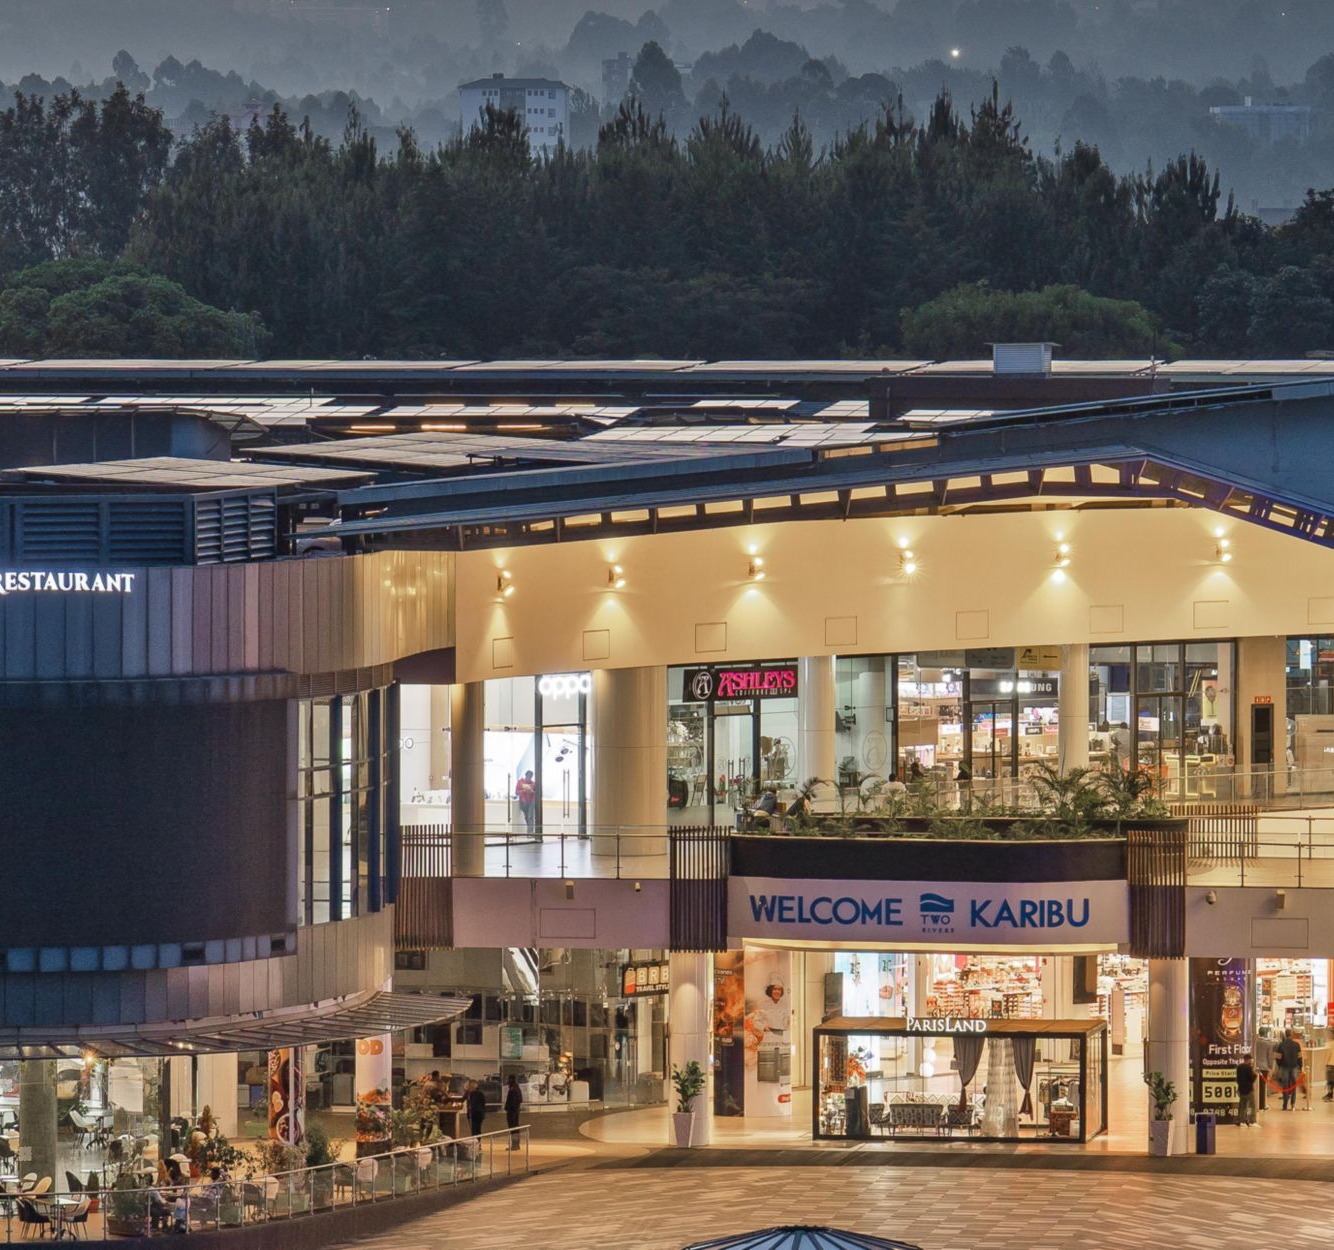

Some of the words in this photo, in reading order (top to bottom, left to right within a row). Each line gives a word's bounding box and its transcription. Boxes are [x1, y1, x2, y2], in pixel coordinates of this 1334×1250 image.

[717, 670, 795, 697] ASHLEYS
[749, 895, 904, 926] WELCOME
[970, 897, 1090, 928] KARIBU
[921, 914, 952, 926] TWO
[1209, 1043, 1232, 1055] First
[1202, 1058, 1228, 1066] Opposite
